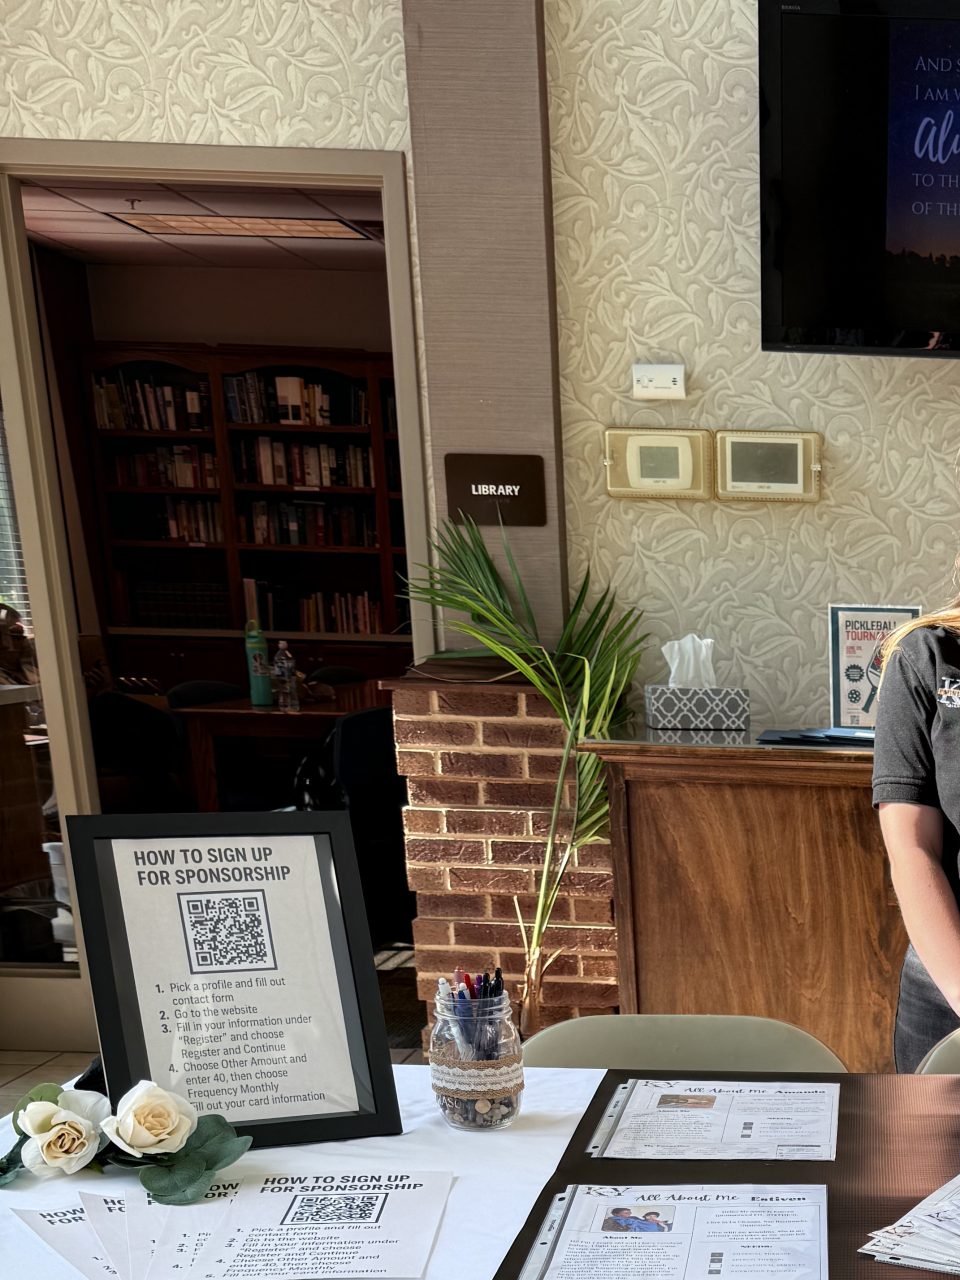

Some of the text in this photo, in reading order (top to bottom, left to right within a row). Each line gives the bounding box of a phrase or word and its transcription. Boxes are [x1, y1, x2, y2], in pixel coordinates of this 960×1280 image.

[915, 57, 952, 72] AND
[915, 84, 919, 101] I
[924, 89, 949, 101] AM
[912, 174, 934, 187] TO
[912, 202, 937, 215] OF
[471, 484, 520, 496] LIBRARY
[134, 847, 273, 866] HOW TO SIGN UP
[138, 866, 291, 886] FOR SPONSORSHIP
[156, 984, 164, 994] 1.
[170, 982, 191, 993] Pick
[202, 980, 233, 994] profile
[236, 979, 252, 989] and
[256, 977, 267, 987] fill
[270, 978, 286, 986] out
[173, 994, 234, 1005] contact form
[160, 1005, 258, 1020] 2. Go to the website
[162, 1015, 312, 1034] 3. Fill in your information under
[231, 1032, 249, 1041] and
[251, 1030, 285, 1039] choose
[181, 1043, 286, 1060] Register and Continue
[169, 1053, 307, 1073] 4. Choose Other Amount and
[186, 1069, 288, 1086] enter 40, then choose
[188, 1082, 280, 1098] Frequency Monthly
[207, 1101, 222, 1111] out
[226, 1099, 245, 1111] your
[249, 1096, 270, 1107] card
[272, 1092, 326, 1104] information
[264, 1177, 308, 1185] HOW
[313, 1176, 336, 1184] TO
[299, 1183, 424, 1192] SPONSORSHIP
[635, 1194, 661, 1202] All
[39, 1207, 85, 1219] HOW
[48, 1216, 85, 1225] FOR
